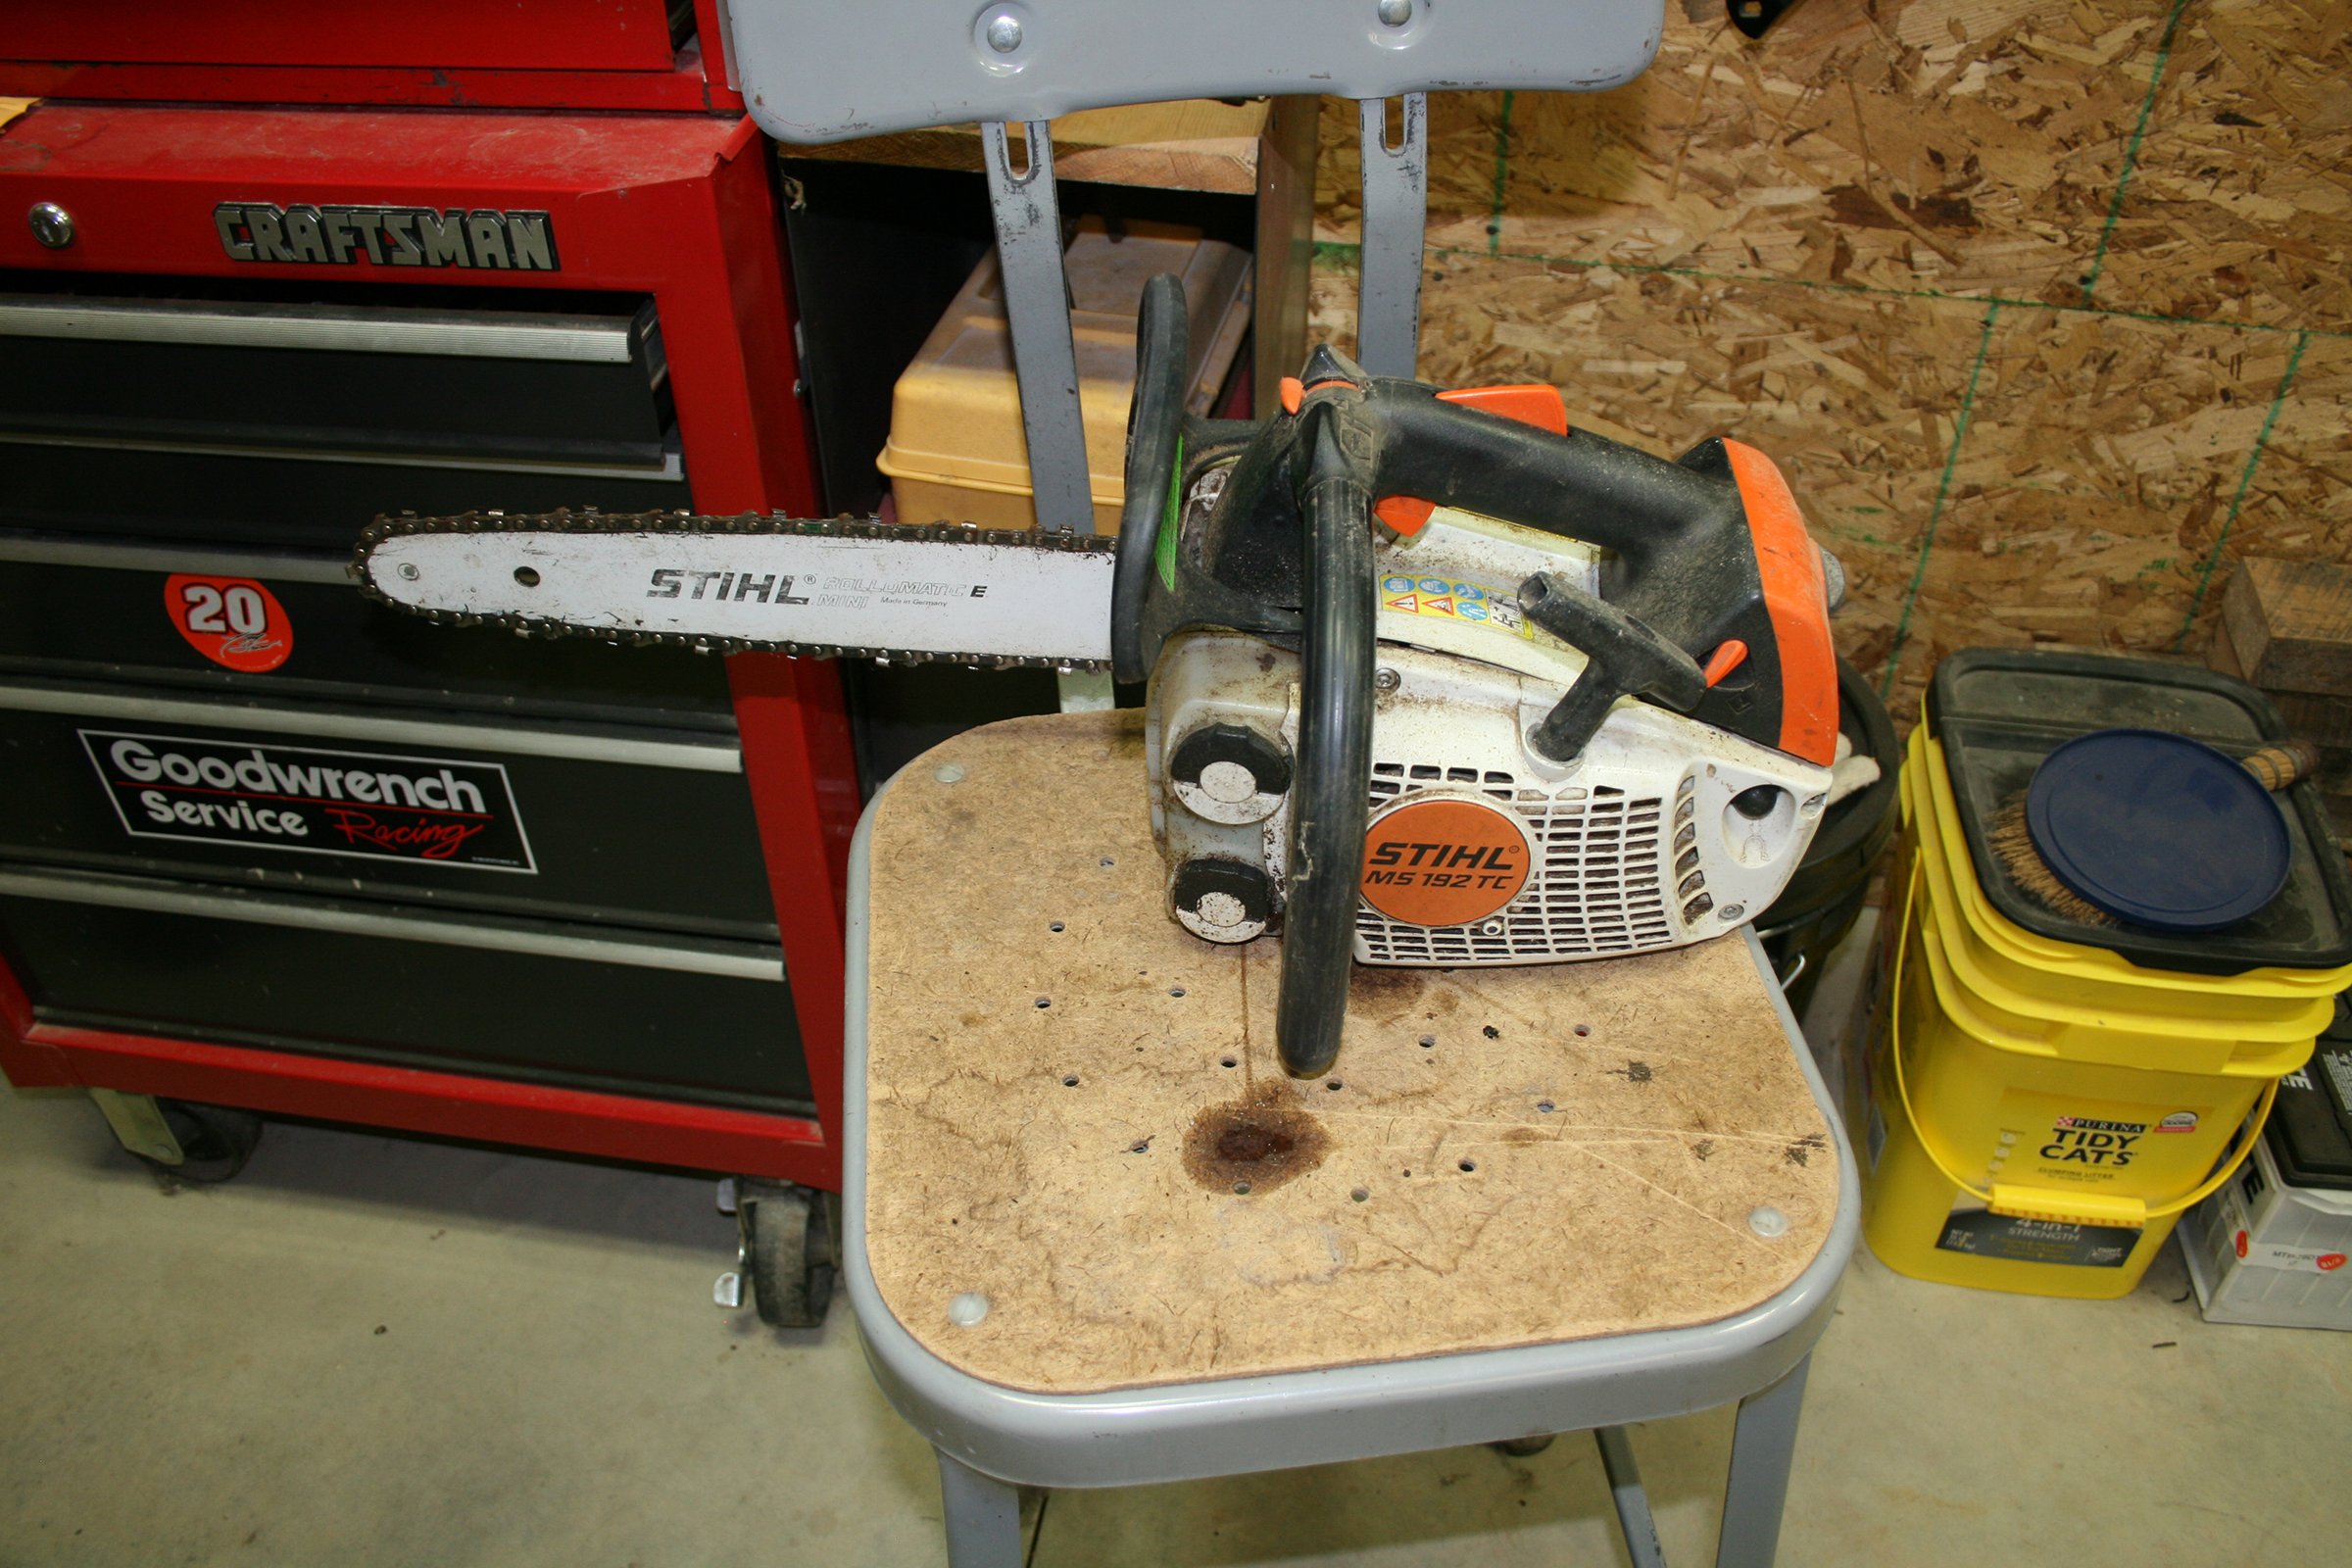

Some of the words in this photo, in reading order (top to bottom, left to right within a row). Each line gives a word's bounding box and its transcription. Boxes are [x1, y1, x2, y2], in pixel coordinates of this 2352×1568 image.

[213, 202, 561, 270] CRAFTSMAN
[647, 568, 808, 605] STIHL
[970, 585, 987, 598] E
[181, 583, 268, 635] 20
[817, 594, 869, 609] MINI
[880, 596, 902, 605] Made
[912, 599, 948, 608] Germany
[111, 740, 486, 813] Goodwrench
[140, 790, 309, 836] Service
[324, 808, 485, 858] Racing
[1369, 842, 1513, 870] STIHL
[1365, 870, 1416, 885] MS
[1421, 873, 1472, 888] 192
[1477, 875, 1514, 889] TC
[2075, 1118, 2143, 1133] PURINA
[2052, 1128, 2140, 1150] TIDY
[2039, 1145, 2133, 1166] CATS
[2007, 1226, 2082, 1243] STRENGTH
